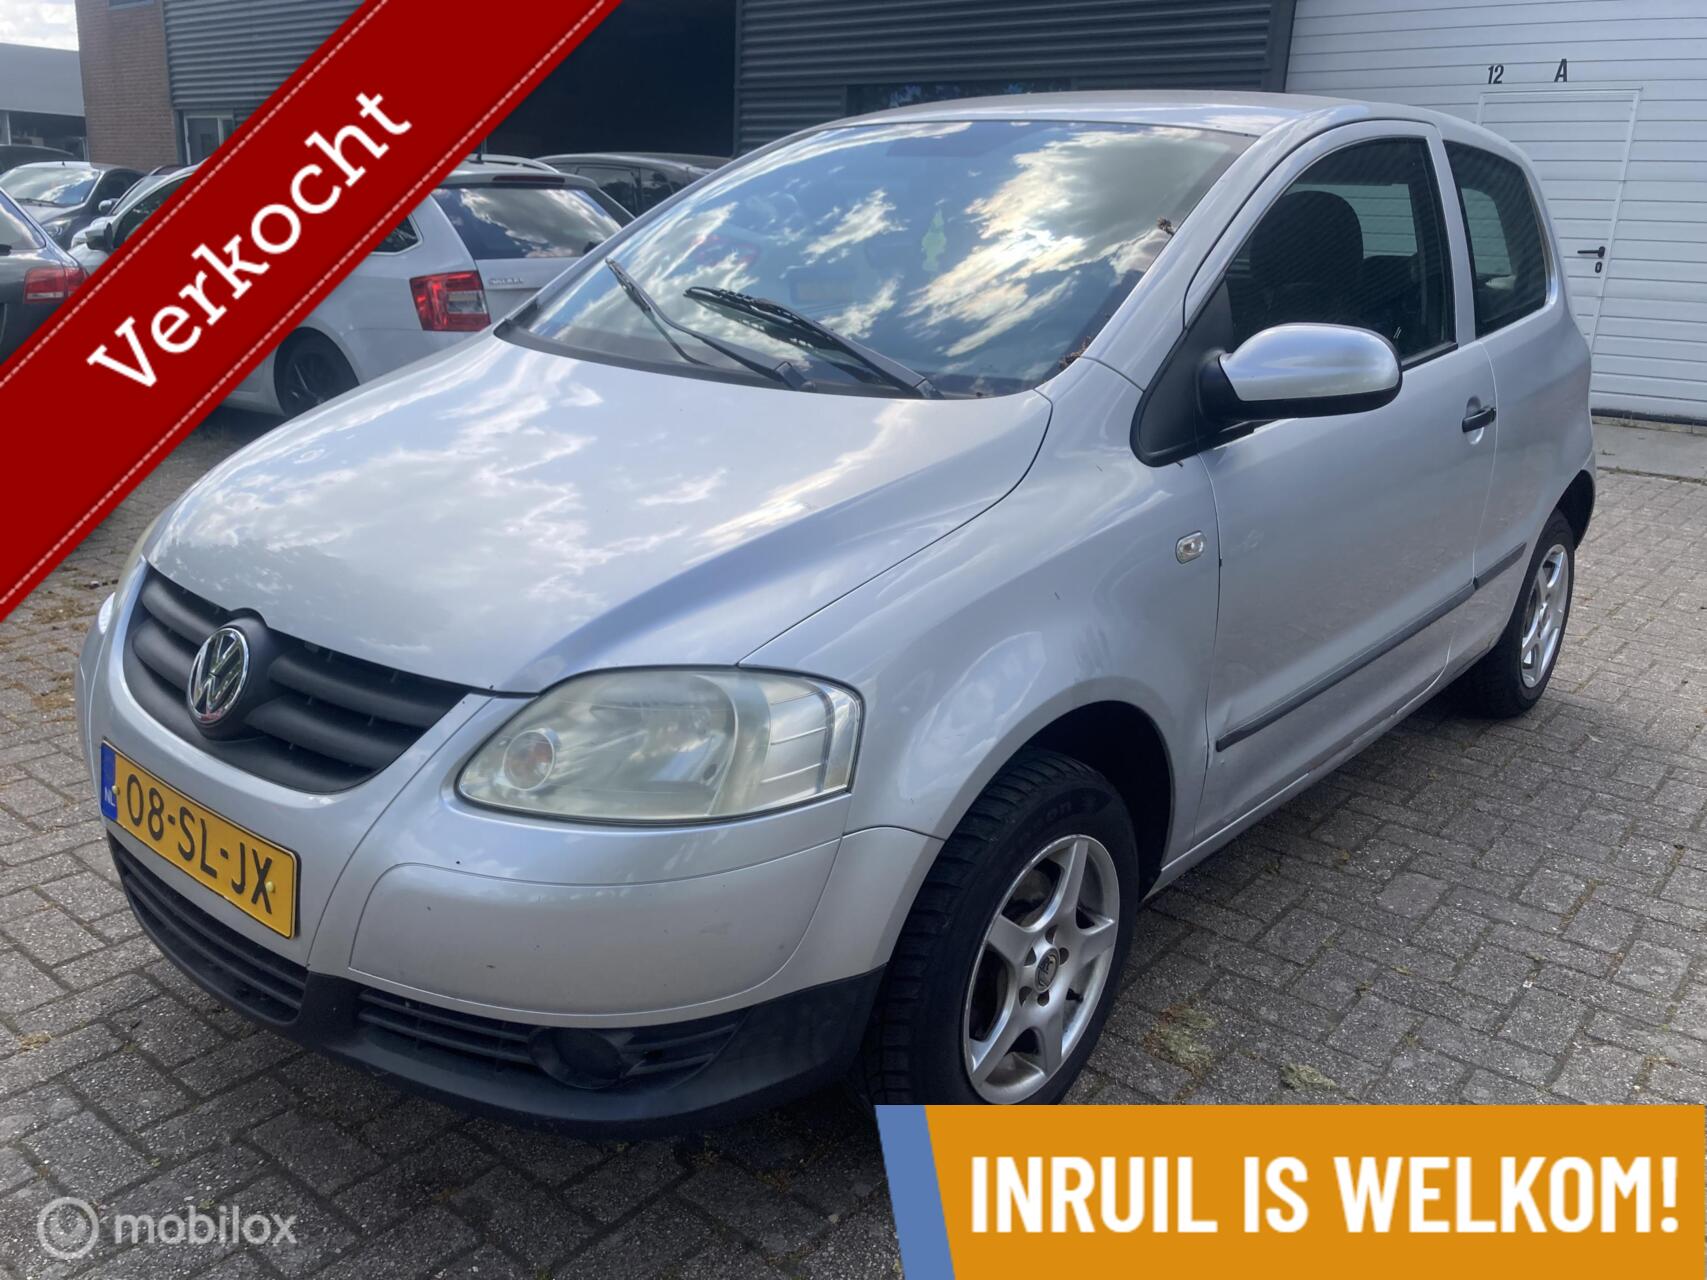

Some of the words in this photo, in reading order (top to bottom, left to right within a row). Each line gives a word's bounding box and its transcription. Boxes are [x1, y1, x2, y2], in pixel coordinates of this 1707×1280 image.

[1487, 64, 1504, 84] 12
[1554, 58, 1568, 83] A
[127, 773, 273, 915] 08-SL-JX
